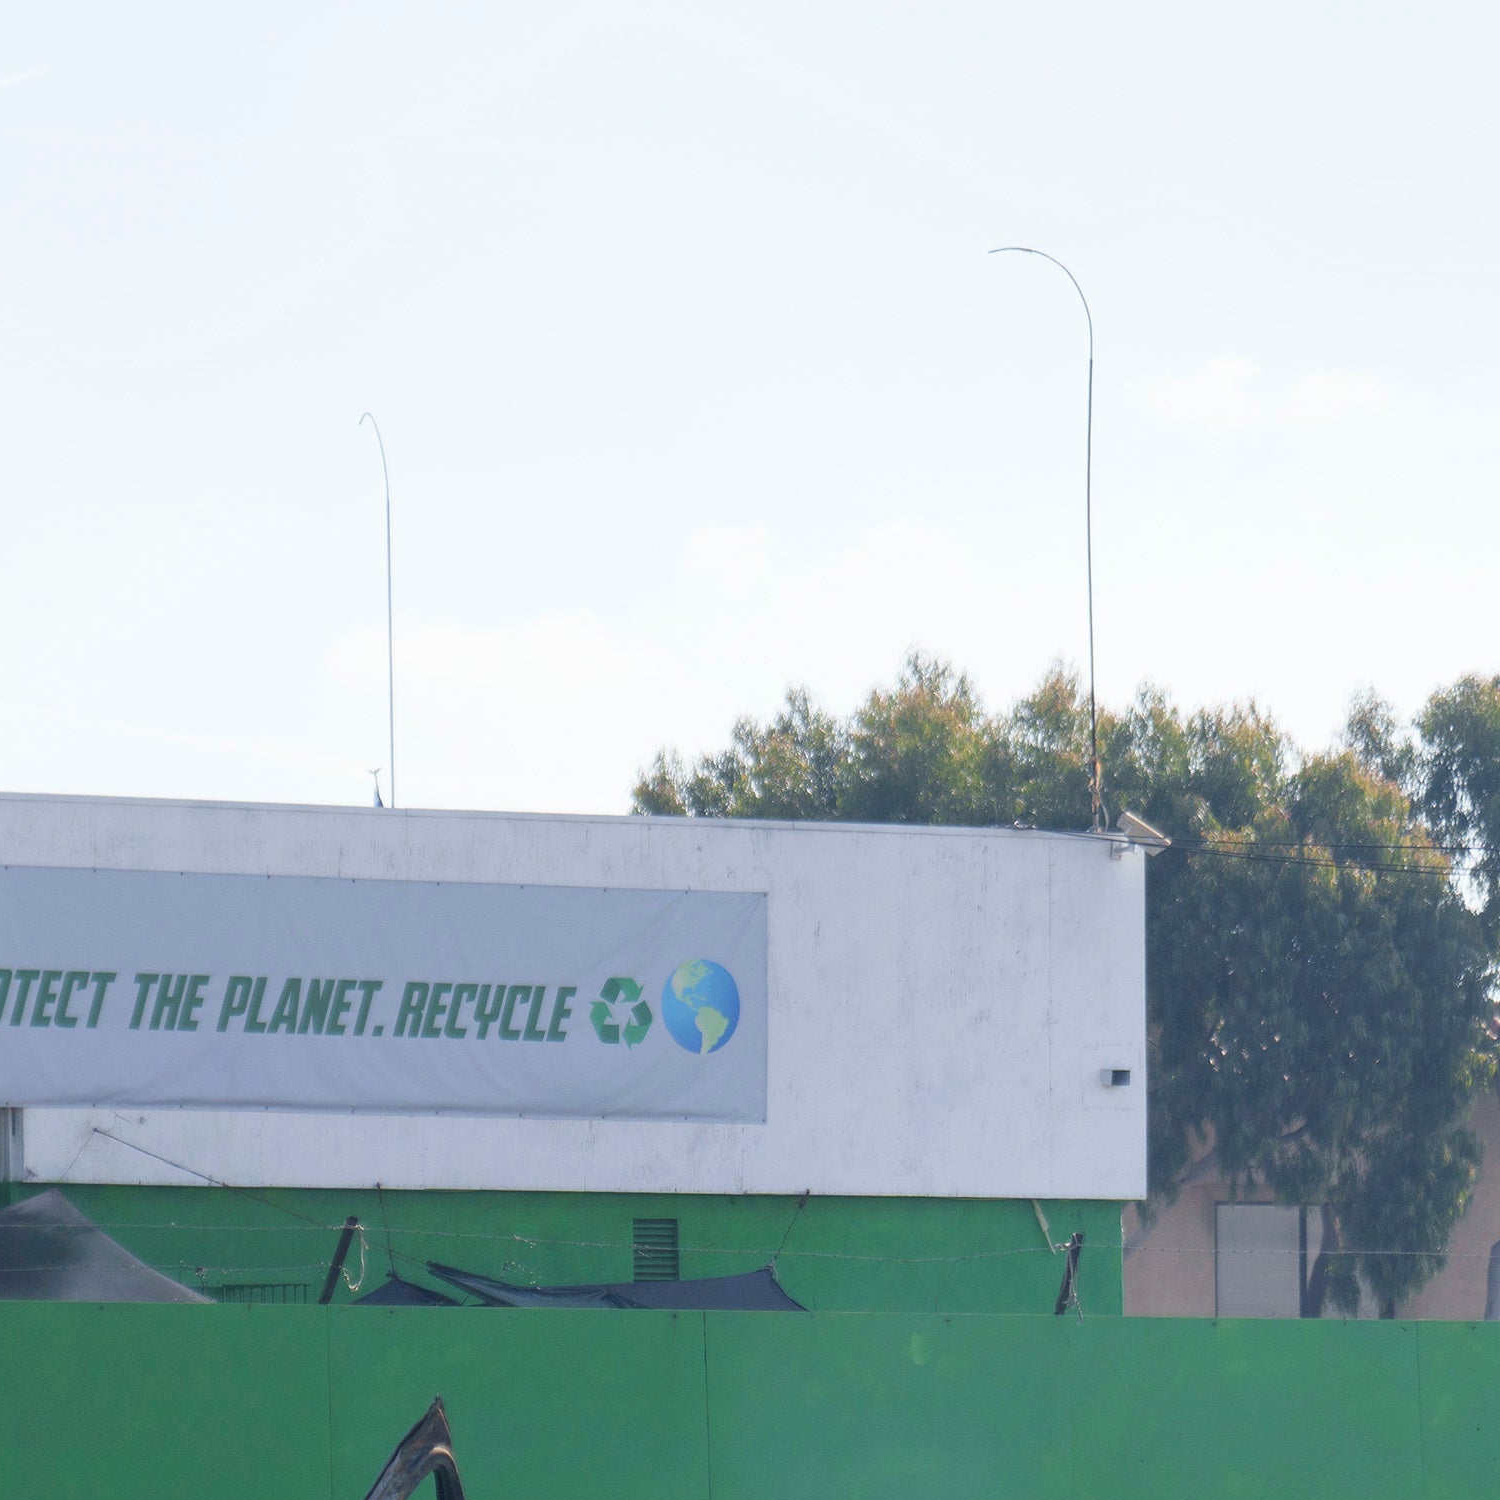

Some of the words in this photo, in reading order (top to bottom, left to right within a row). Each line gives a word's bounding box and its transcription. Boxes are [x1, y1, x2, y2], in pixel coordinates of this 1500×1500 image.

[128, 972, 211, 1032] THE
[215, 975, 385, 1038] PLANET.
[392, 981, 578, 1043] RECYCLE
